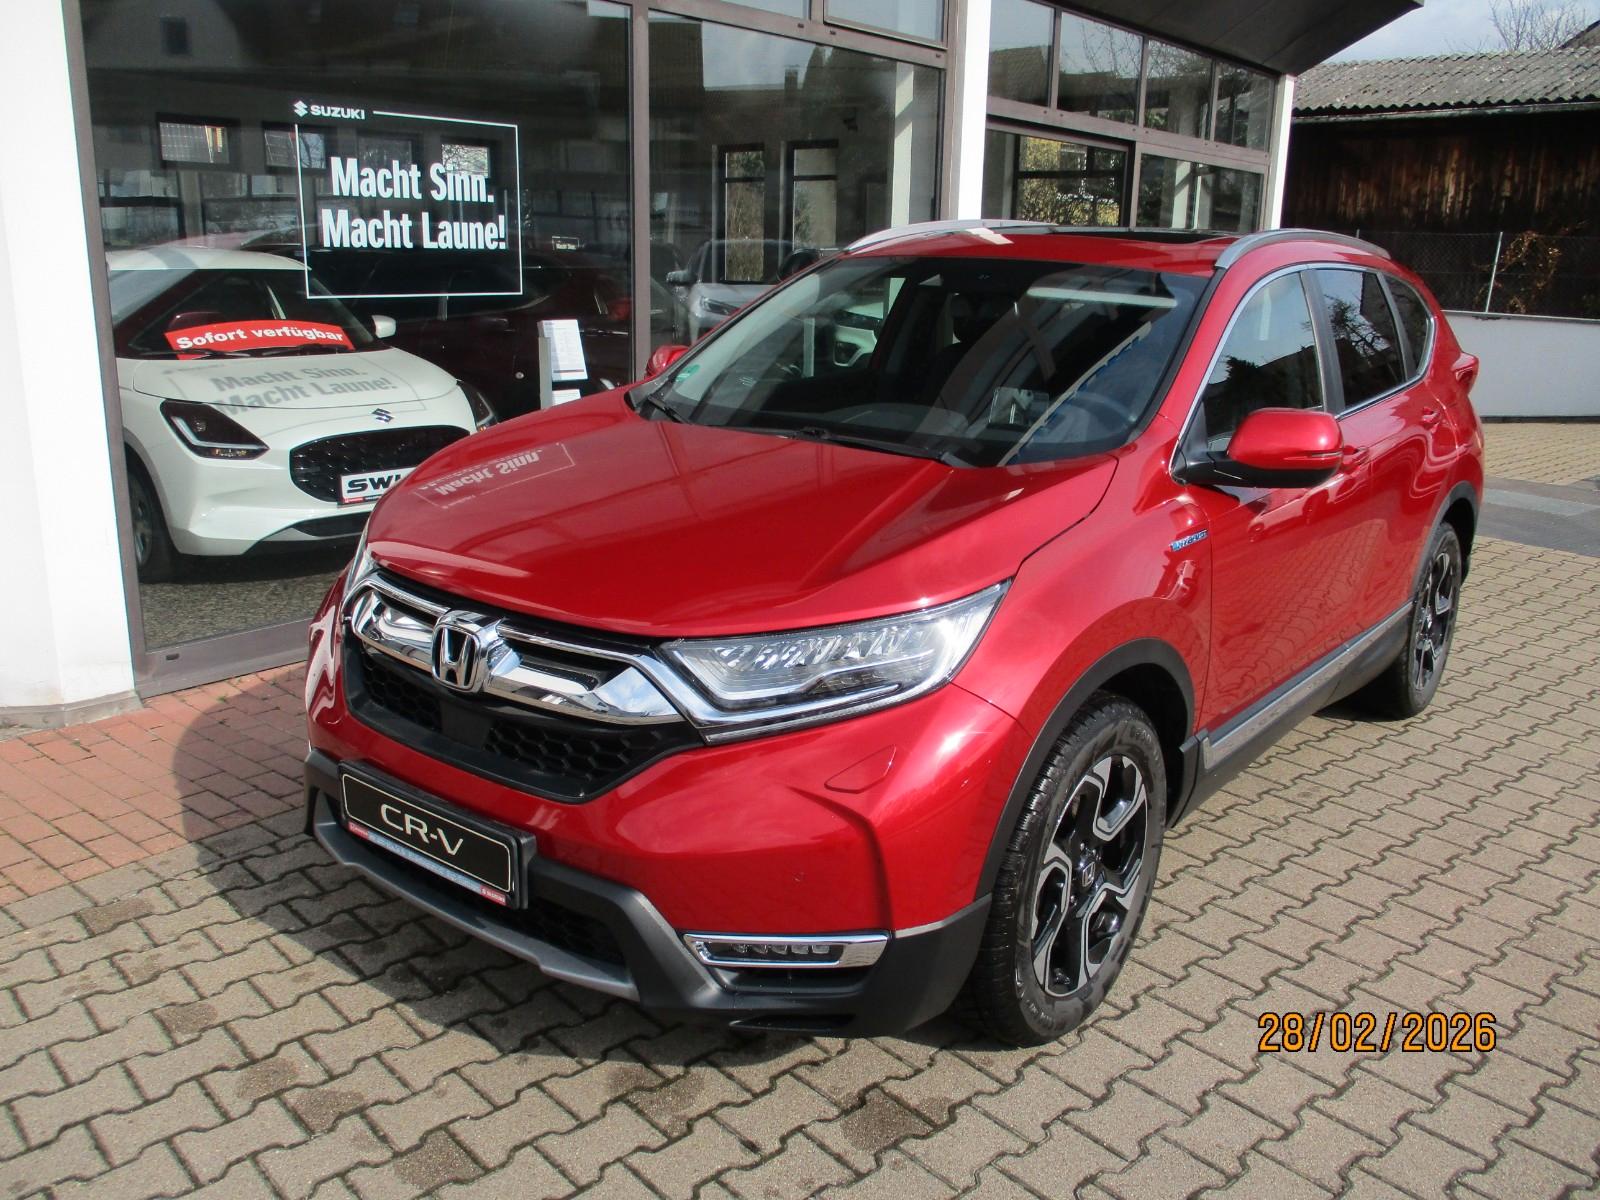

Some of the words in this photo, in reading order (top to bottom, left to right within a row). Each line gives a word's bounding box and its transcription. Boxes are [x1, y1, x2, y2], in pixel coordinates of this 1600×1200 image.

[310, 105, 365, 120] SUZUKI
[331, 156, 422, 200] Macht
[429, 162, 495, 203] Sinn.
[321, 208, 414, 249] Macht
[421, 212, 507, 250] Laune!
[176, 328, 247, 349] Sofort
[251, 325, 344, 342] verfügbar
[380, 803, 464, 856] CR-V
